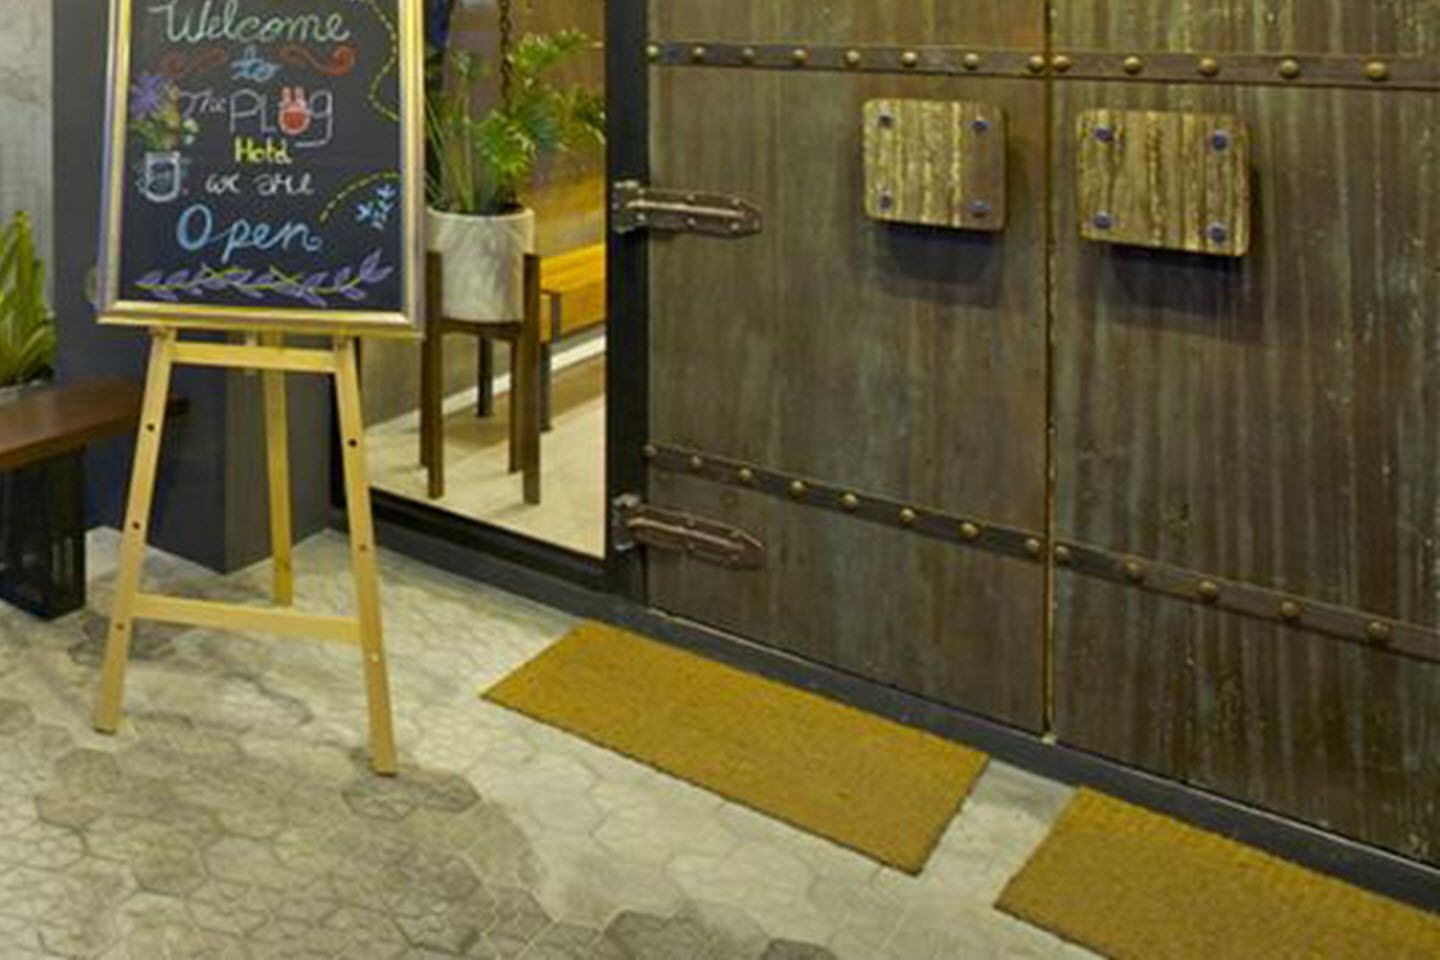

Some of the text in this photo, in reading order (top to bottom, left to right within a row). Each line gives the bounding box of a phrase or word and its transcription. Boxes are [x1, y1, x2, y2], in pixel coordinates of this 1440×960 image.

[231, 45, 280, 81] to
[180, 88, 228, 118] The
[205, 171, 316, 196] we are
[176, 203, 324, 264] Open
